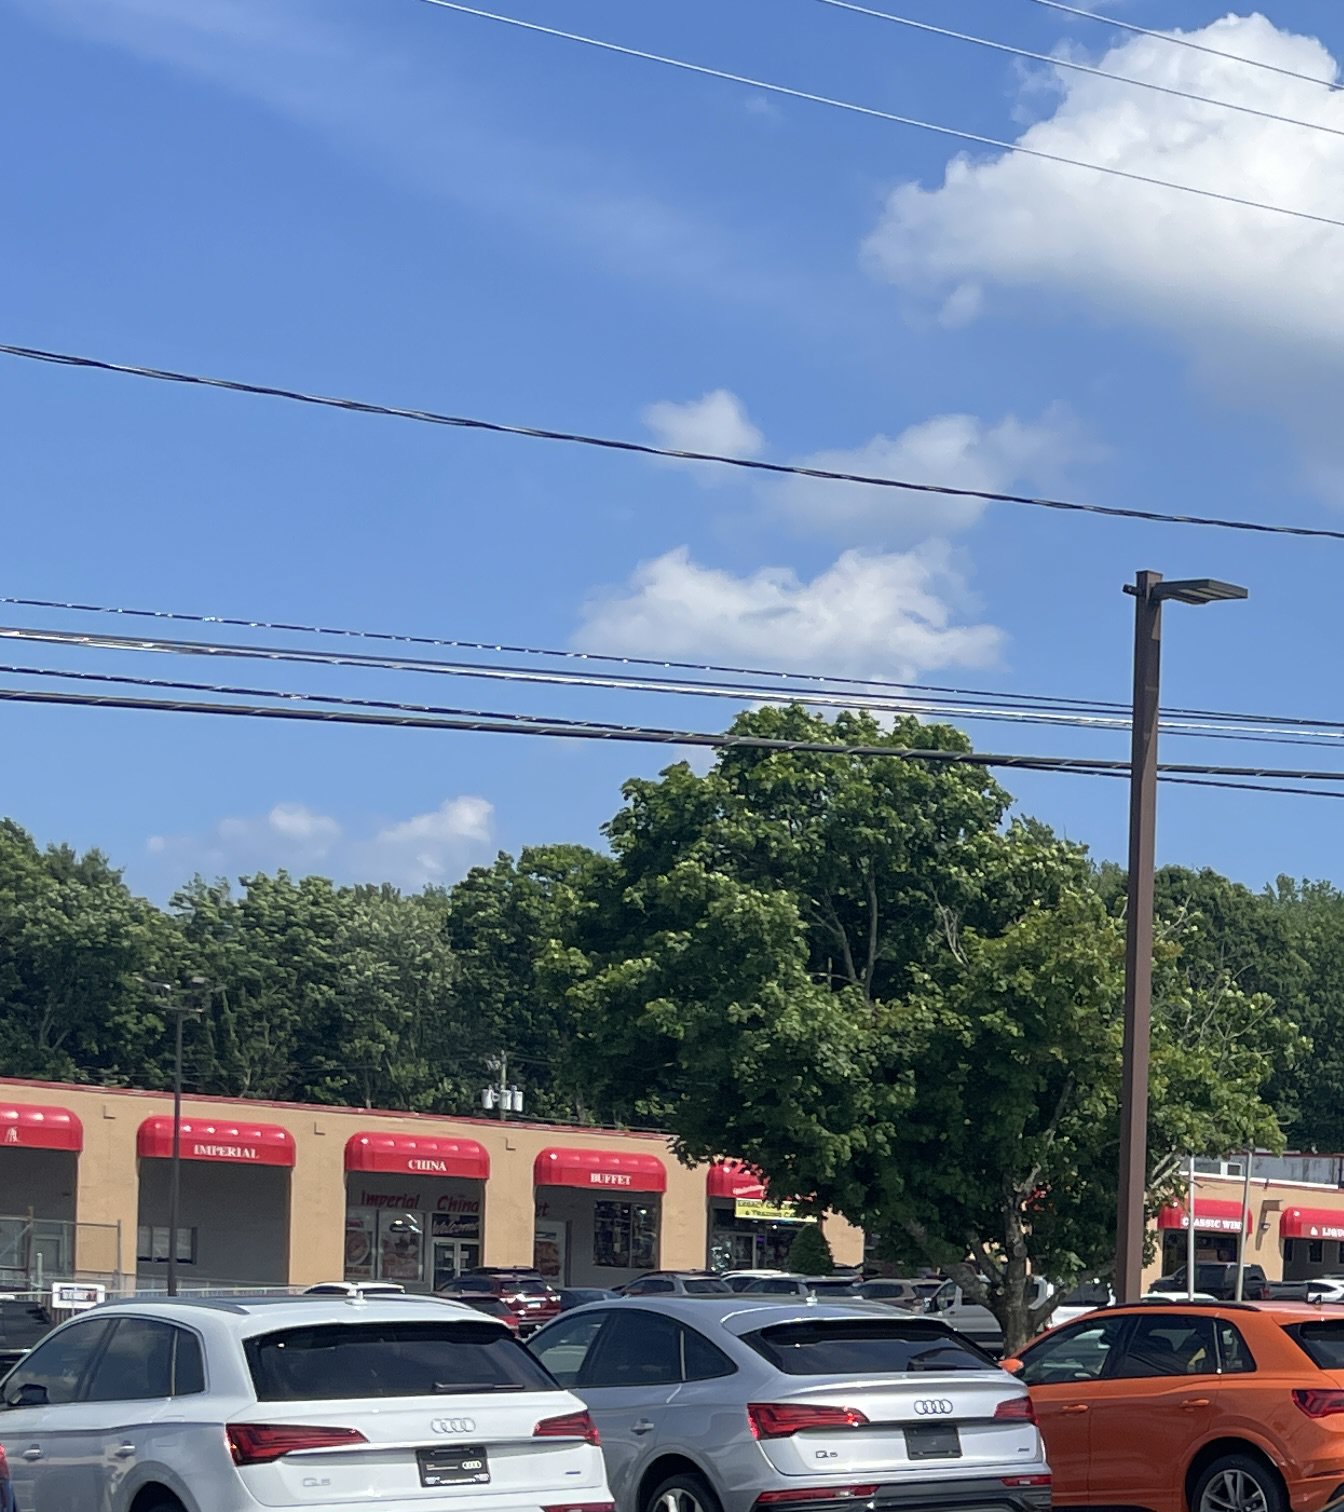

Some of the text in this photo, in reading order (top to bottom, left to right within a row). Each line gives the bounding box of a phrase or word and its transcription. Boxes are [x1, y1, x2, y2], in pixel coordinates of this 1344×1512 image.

[194, 1144, 259, 1159] IMPERIAL
[408, 1159, 447, 1171] CHINA
[590, 1173, 631, 1185] BUFFET
[361, 1191, 420, 1209] Imperial
